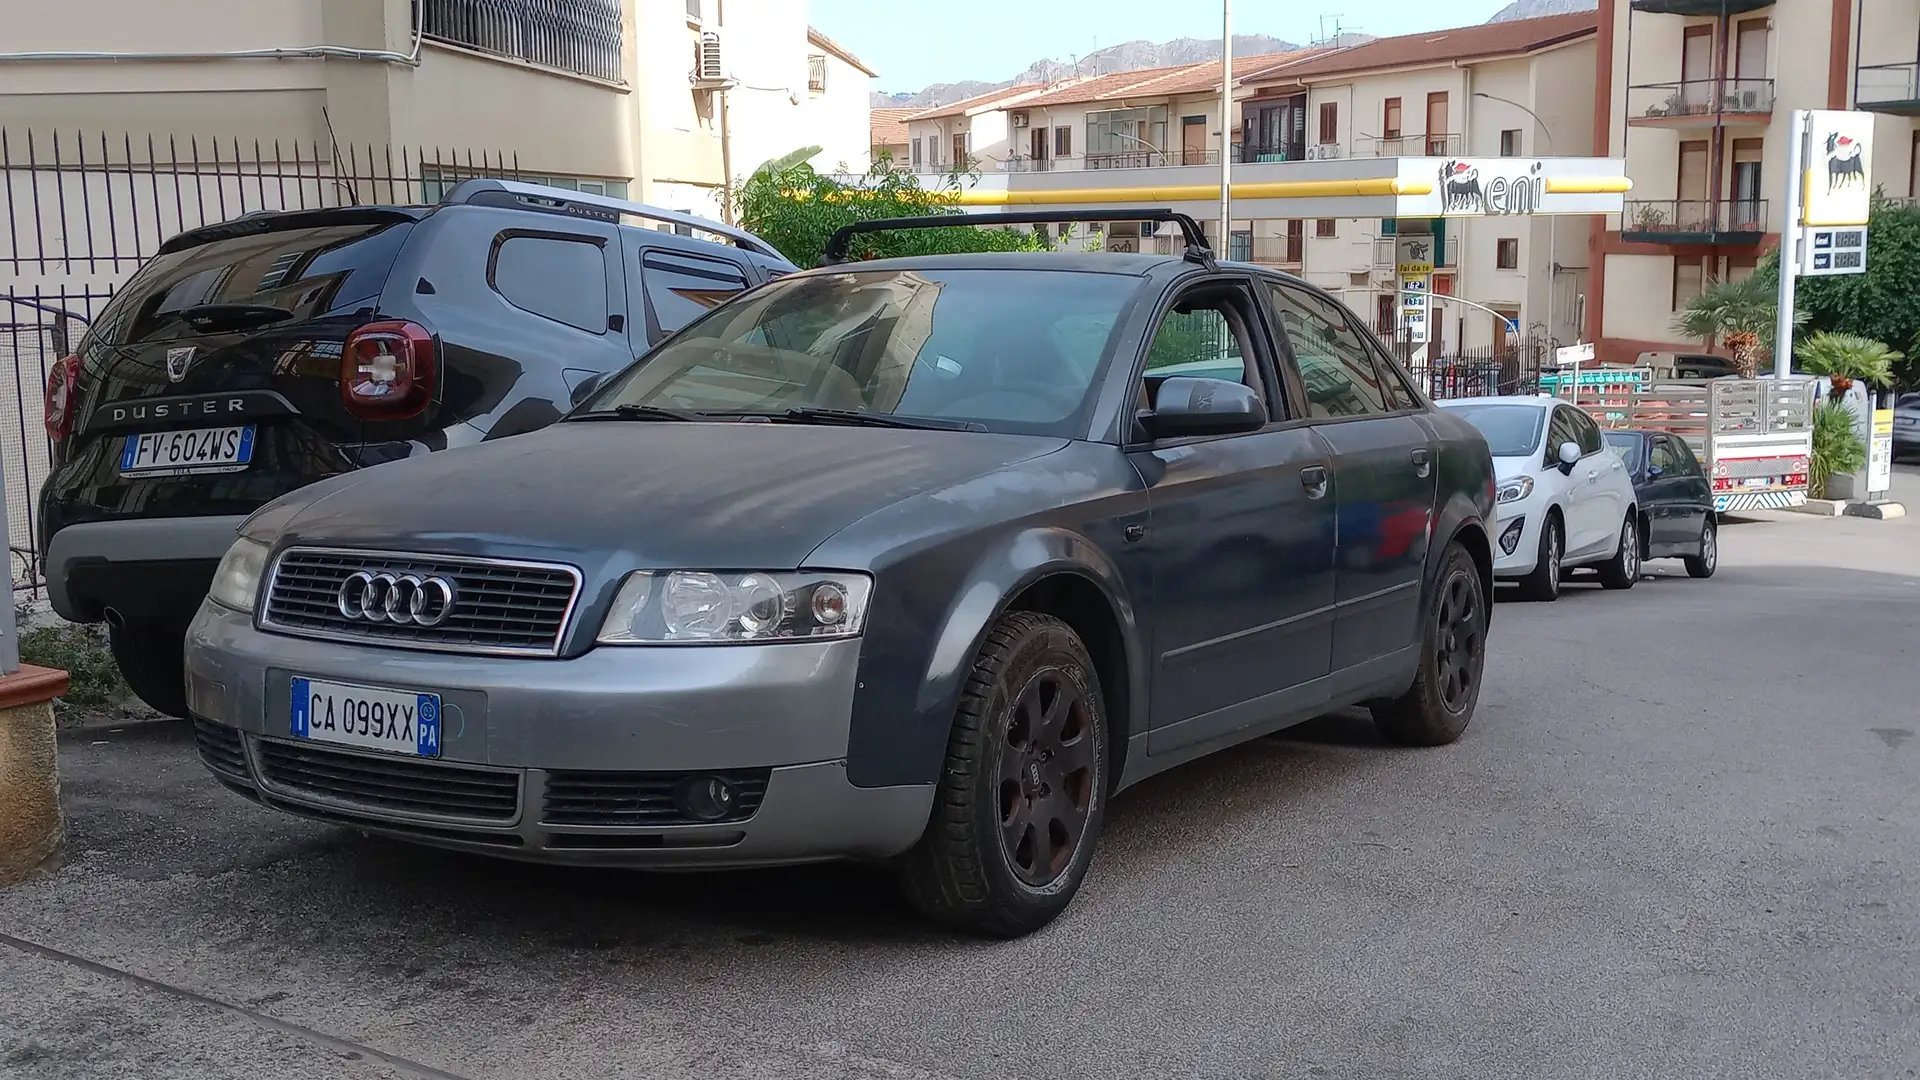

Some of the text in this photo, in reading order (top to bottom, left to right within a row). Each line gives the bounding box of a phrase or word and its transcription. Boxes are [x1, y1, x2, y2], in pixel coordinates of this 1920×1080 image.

[1487, 161, 1543, 213] eni
[568, 206, 616, 220] DUSTER
[1400, 264, 1410, 272] fai
[1411, 264, 1421, 272] da
[113, 399, 244, 421] DUSTER
[419, 723, 437, 747] PA
